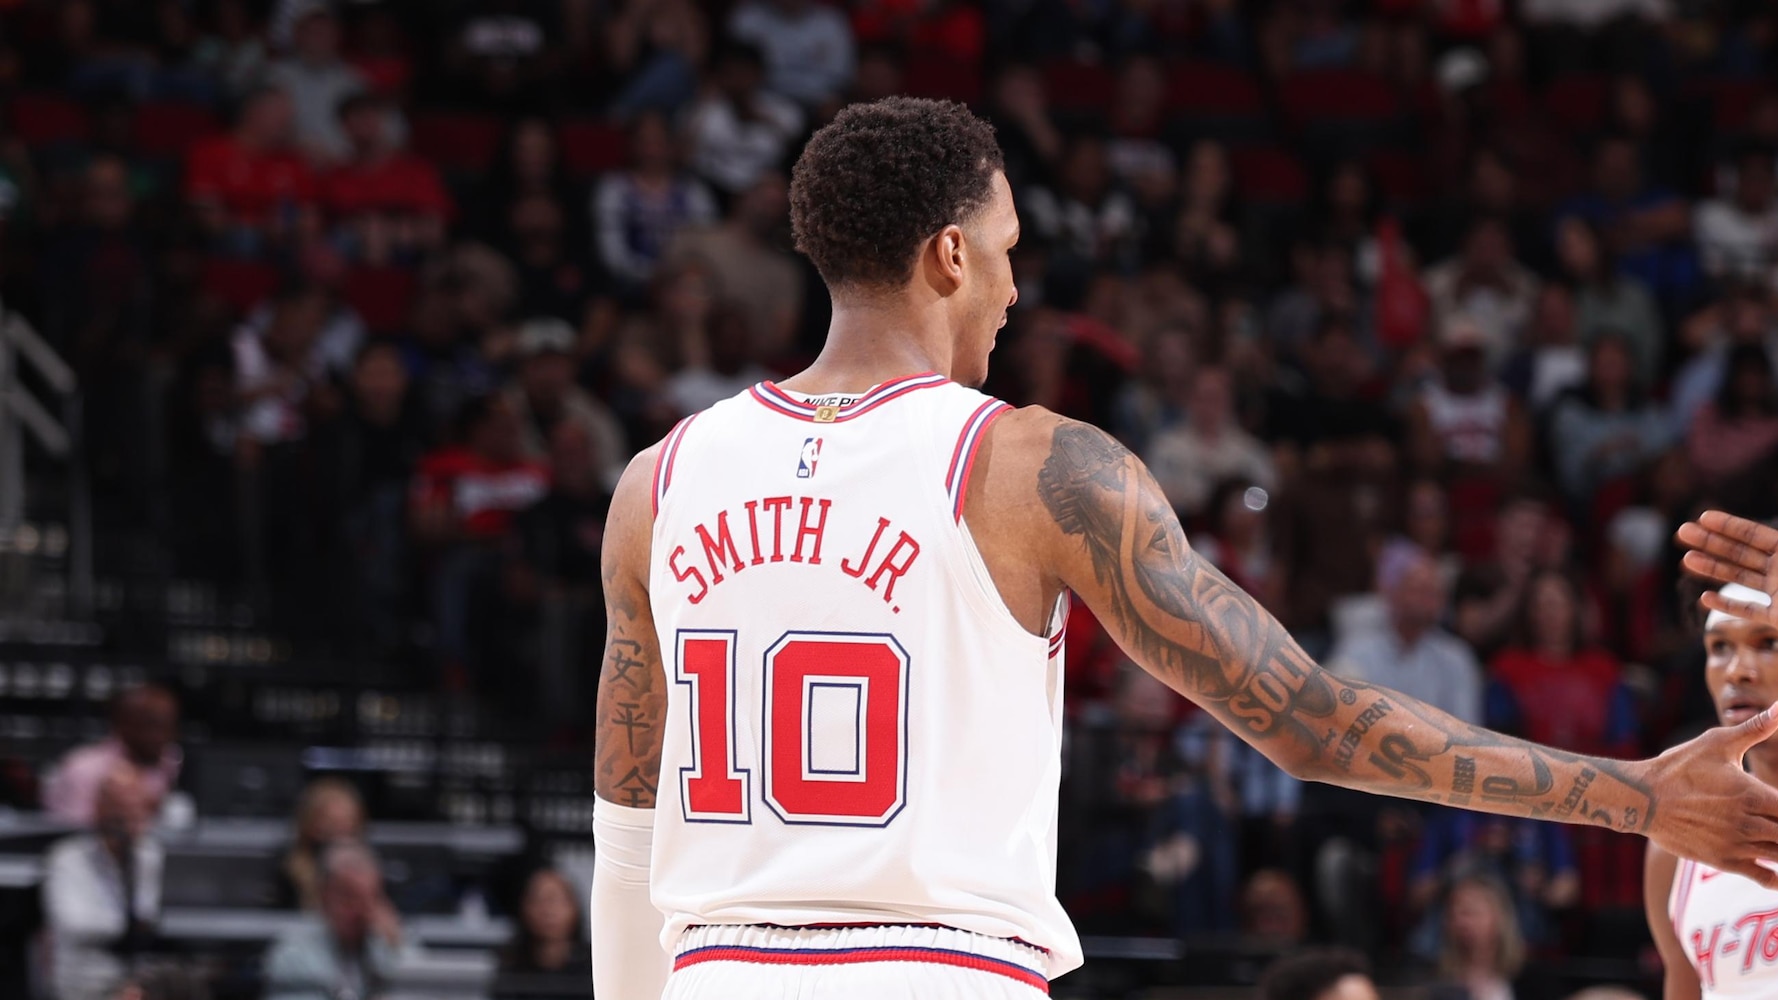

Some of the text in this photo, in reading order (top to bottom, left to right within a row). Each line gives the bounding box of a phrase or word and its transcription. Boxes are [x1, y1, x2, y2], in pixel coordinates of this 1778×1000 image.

[668, 495, 920, 614] SMITH JR.
[675, 629, 911, 828] 10
[1334, 698, 1394, 772] AUBURN
